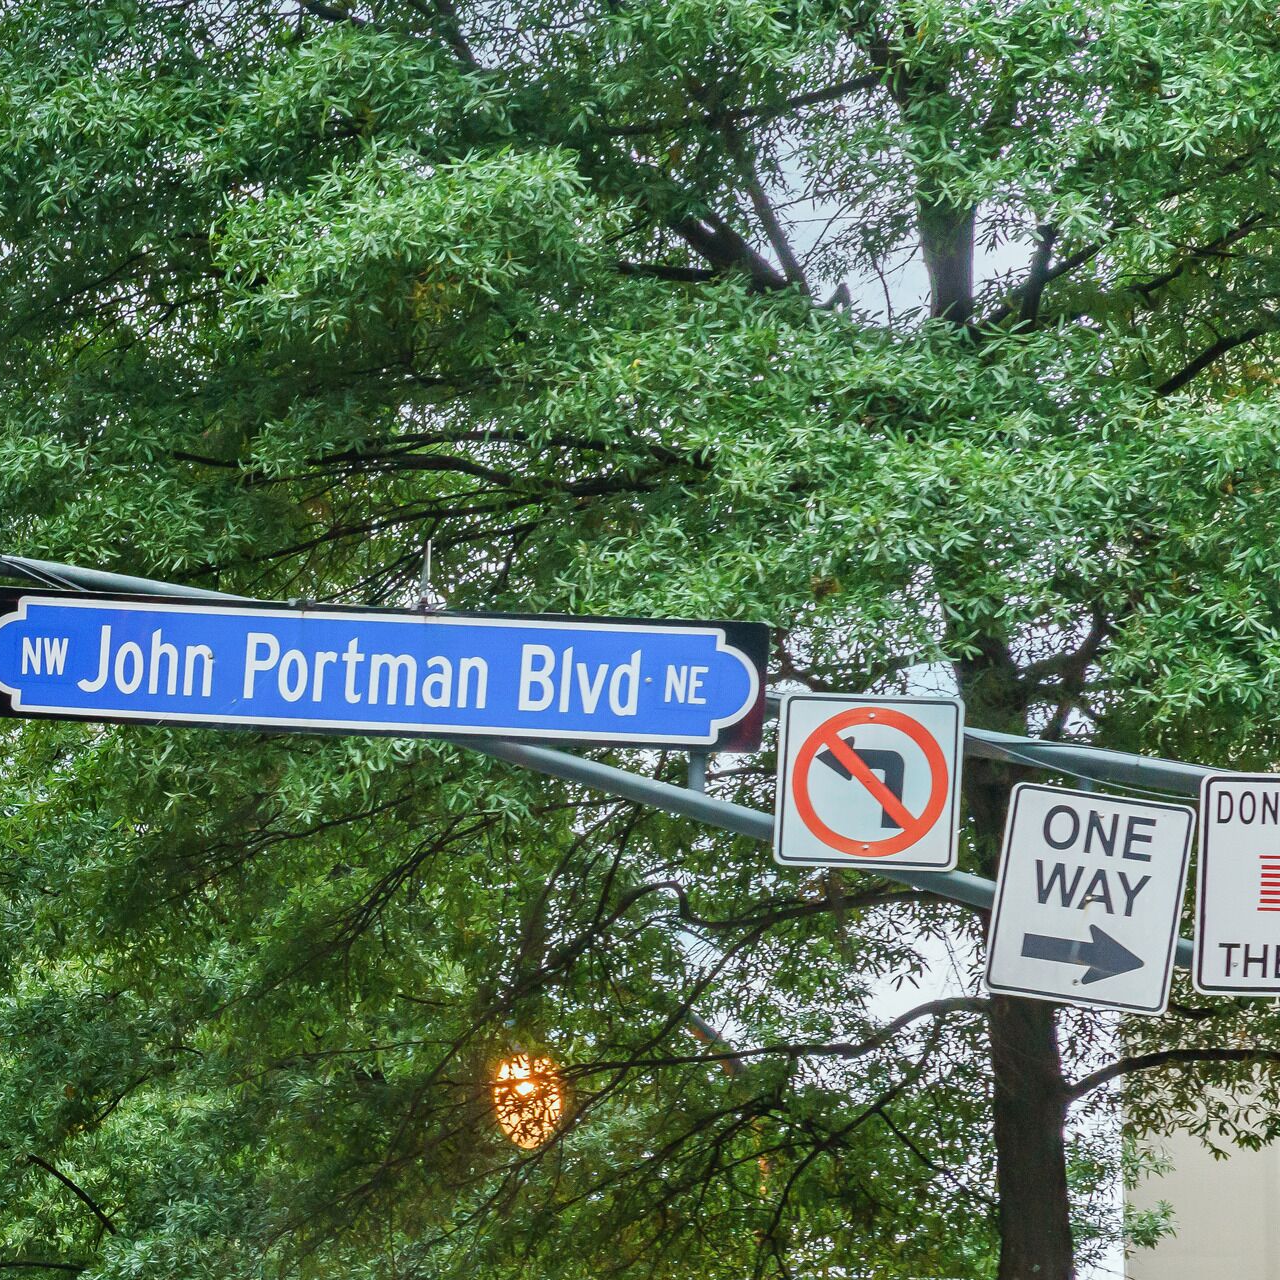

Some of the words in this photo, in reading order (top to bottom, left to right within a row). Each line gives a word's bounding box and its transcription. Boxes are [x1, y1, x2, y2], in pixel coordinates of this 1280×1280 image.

[20, 636, 68, 675] NW
[77, 624, 214, 697] John
[243, 631, 489, 710] Portman
[518, 643, 642, 717] Blvd
[663, 664, 710, 706] NE
[1043, 804, 1158, 862] ONE
[1035, 859, 1152, 918] WAY
